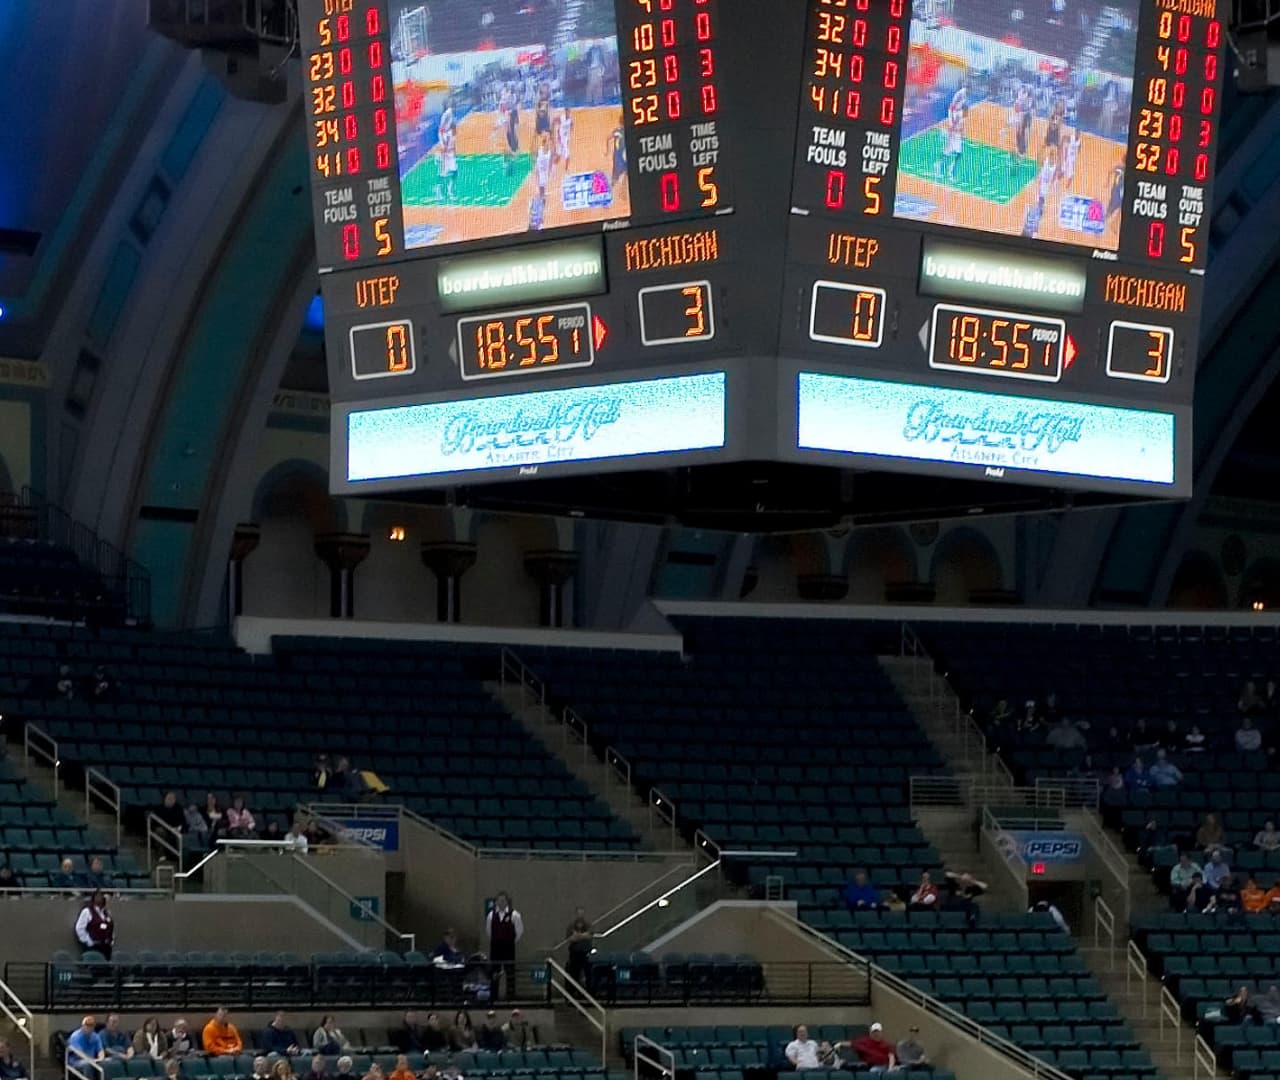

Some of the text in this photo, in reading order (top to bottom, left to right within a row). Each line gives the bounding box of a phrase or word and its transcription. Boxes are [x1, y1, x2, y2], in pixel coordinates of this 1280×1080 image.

[318, 8, 379, 46] 5 0 0
[634, 13, 711, 51] 10 0 0
[818, 13, 900, 53] 32 0 0
[1159, 12, 1220, 48] 0 0 0
[310, 41, 382, 81] 23 0 0
[629, 48, 713, 89] 23 0 3
[814, 48, 897, 88] 34 0 0
[1158, 45, 1217, 80] 4 0 0
[312, 74, 384, 115] 32 0 0
[632, 85, 716, 125] 52 0 0
[811, 85, 894, 124] 41 0 0
[1148, 78, 1214, 114] 10 0 0
[315, 108, 387, 147] 34 0 0
[640, 134, 672, 154] TEAM
[690, 122, 716, 137] TIME
[690, 137, 719, 152] OUTS
[812, 126, 846, 147] TEAM
[865, 131, 890, 147] TIME
[1139, 109, 1211, 147] 23 0 3
[316, 142, 389, 177] 41 0 0
[638, 153, 677, 173] FOULS
[693, 151, 717, 166] LEFT
[808, 146, 846, 167] FOULS
[862, 146, 890, 161] OUTS
[862, 160, 889, 175] LEFT
[1136, 143, 1208, 180] 52 0 0
[325, 188, 353, 206] TEAM
[367, 190, 392, 205] OUTS
[368, 177, 390, 190] TIME
[662, 166, 717, 212] 0 5
[826, 170, 881, 214] 0 5
[1137, 182, 1166, 200] TEAM
[1182, 186, 1203, 199] TIME
[324, 205, 357, 224] FOULS
[370, 204, 391, 218] LEFT
[1133, 199, 1167, 219] FOULS
[1179, 199, 1203, 214] OUTS
[1179, 213, 1202, 226] LEFT
[343, 218, 392, 260] 0 5
[625, 230, 718, 272] MICHIGAN
[828, 234, 879, 268] UTEP
[1148, 222, 1195, 262] 0 5
[356, 275, 399, 308] UTEP
[443, 259, 599, 295] boardwalkhall.com
[926, 257, 1081, 297] boardwalkhall.com
[1105, 274, 1186, 312] MICHIGAN
[558, 316, 584, 329] PERIOD
[681, 285, 705, 337] 3
[852, 292, 875, 340] 0
[387, 325, 407, 372] 0
[476, 315, 580, 369] 18:55 1
[950, 317, 1050, 369] 18:55 1
[1032, 328, 1058, 343] PERIOD
[1145, 331, 1164, 377] 3
[1030, 842, 1080, 857] PEPSI
